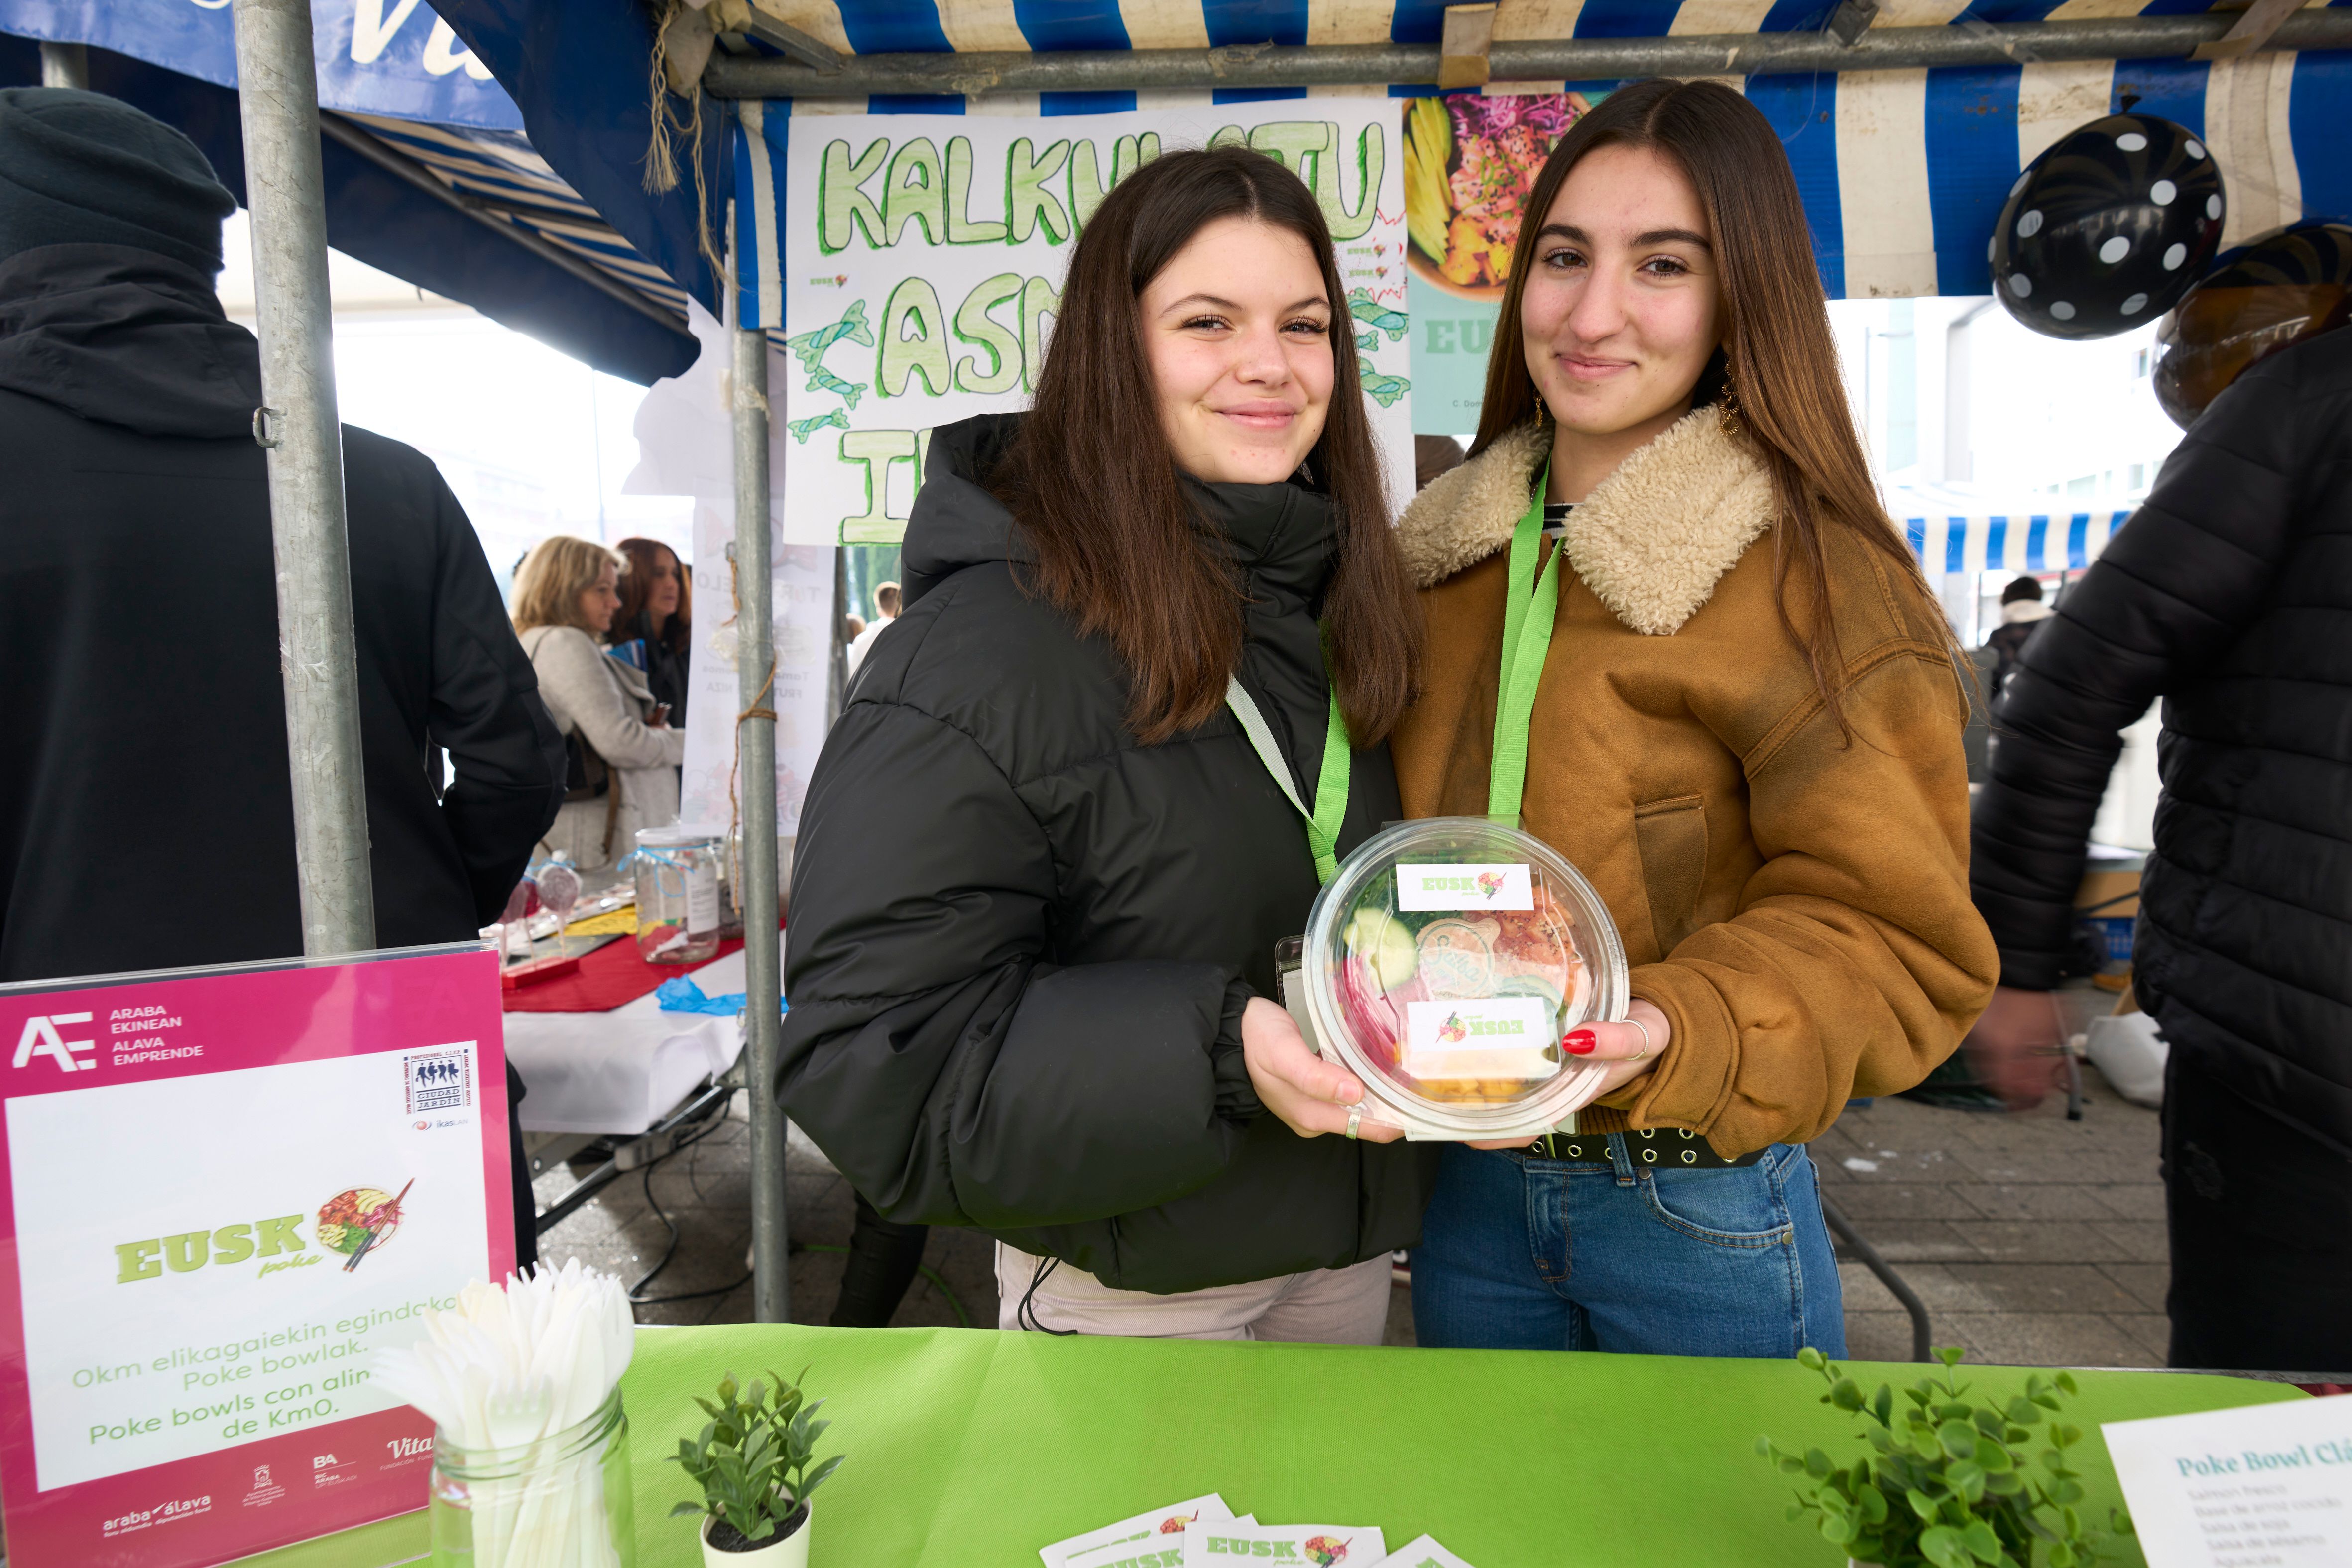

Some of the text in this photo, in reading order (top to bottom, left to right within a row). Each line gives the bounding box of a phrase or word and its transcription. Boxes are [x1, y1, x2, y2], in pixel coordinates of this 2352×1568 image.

[1422, 877, 1475, 891] EUSK
[109, 1005, 167, 1021] ARABA
[111, 1016, 182, 1034] EKINEAN
[1469, 1019, 1525, 1036] EUSK
[113, 1045, 204, 1066] EMPRENDE
[418, 1089, 460, 1099] CIUDAD
[418, 1096, 461, 1109] JARDÍN
[115, 1213, 306, 1284] EUSK
[257, 1253, 323, 1279] poke
[152, 1323, 327, 1371] elikagaiekin
[184, 1338, 369, 1391] Poke bowlak.
[90, 1417, 162, 1445] Poke
[172, 1394, 255, 1427] bowls
[264, 1382, 313, 1405] con
[223, 1419, 259, 1439] de
[387, 1437, 434, 1459] Vita
[2176, 1437, 2352, 1477] Poke Bowl Clá
[313, 1453, 338, 1469] BA
[103, 1511, 151, 1531] araba
[1206, 1536, 1297, 1558] EUSK
